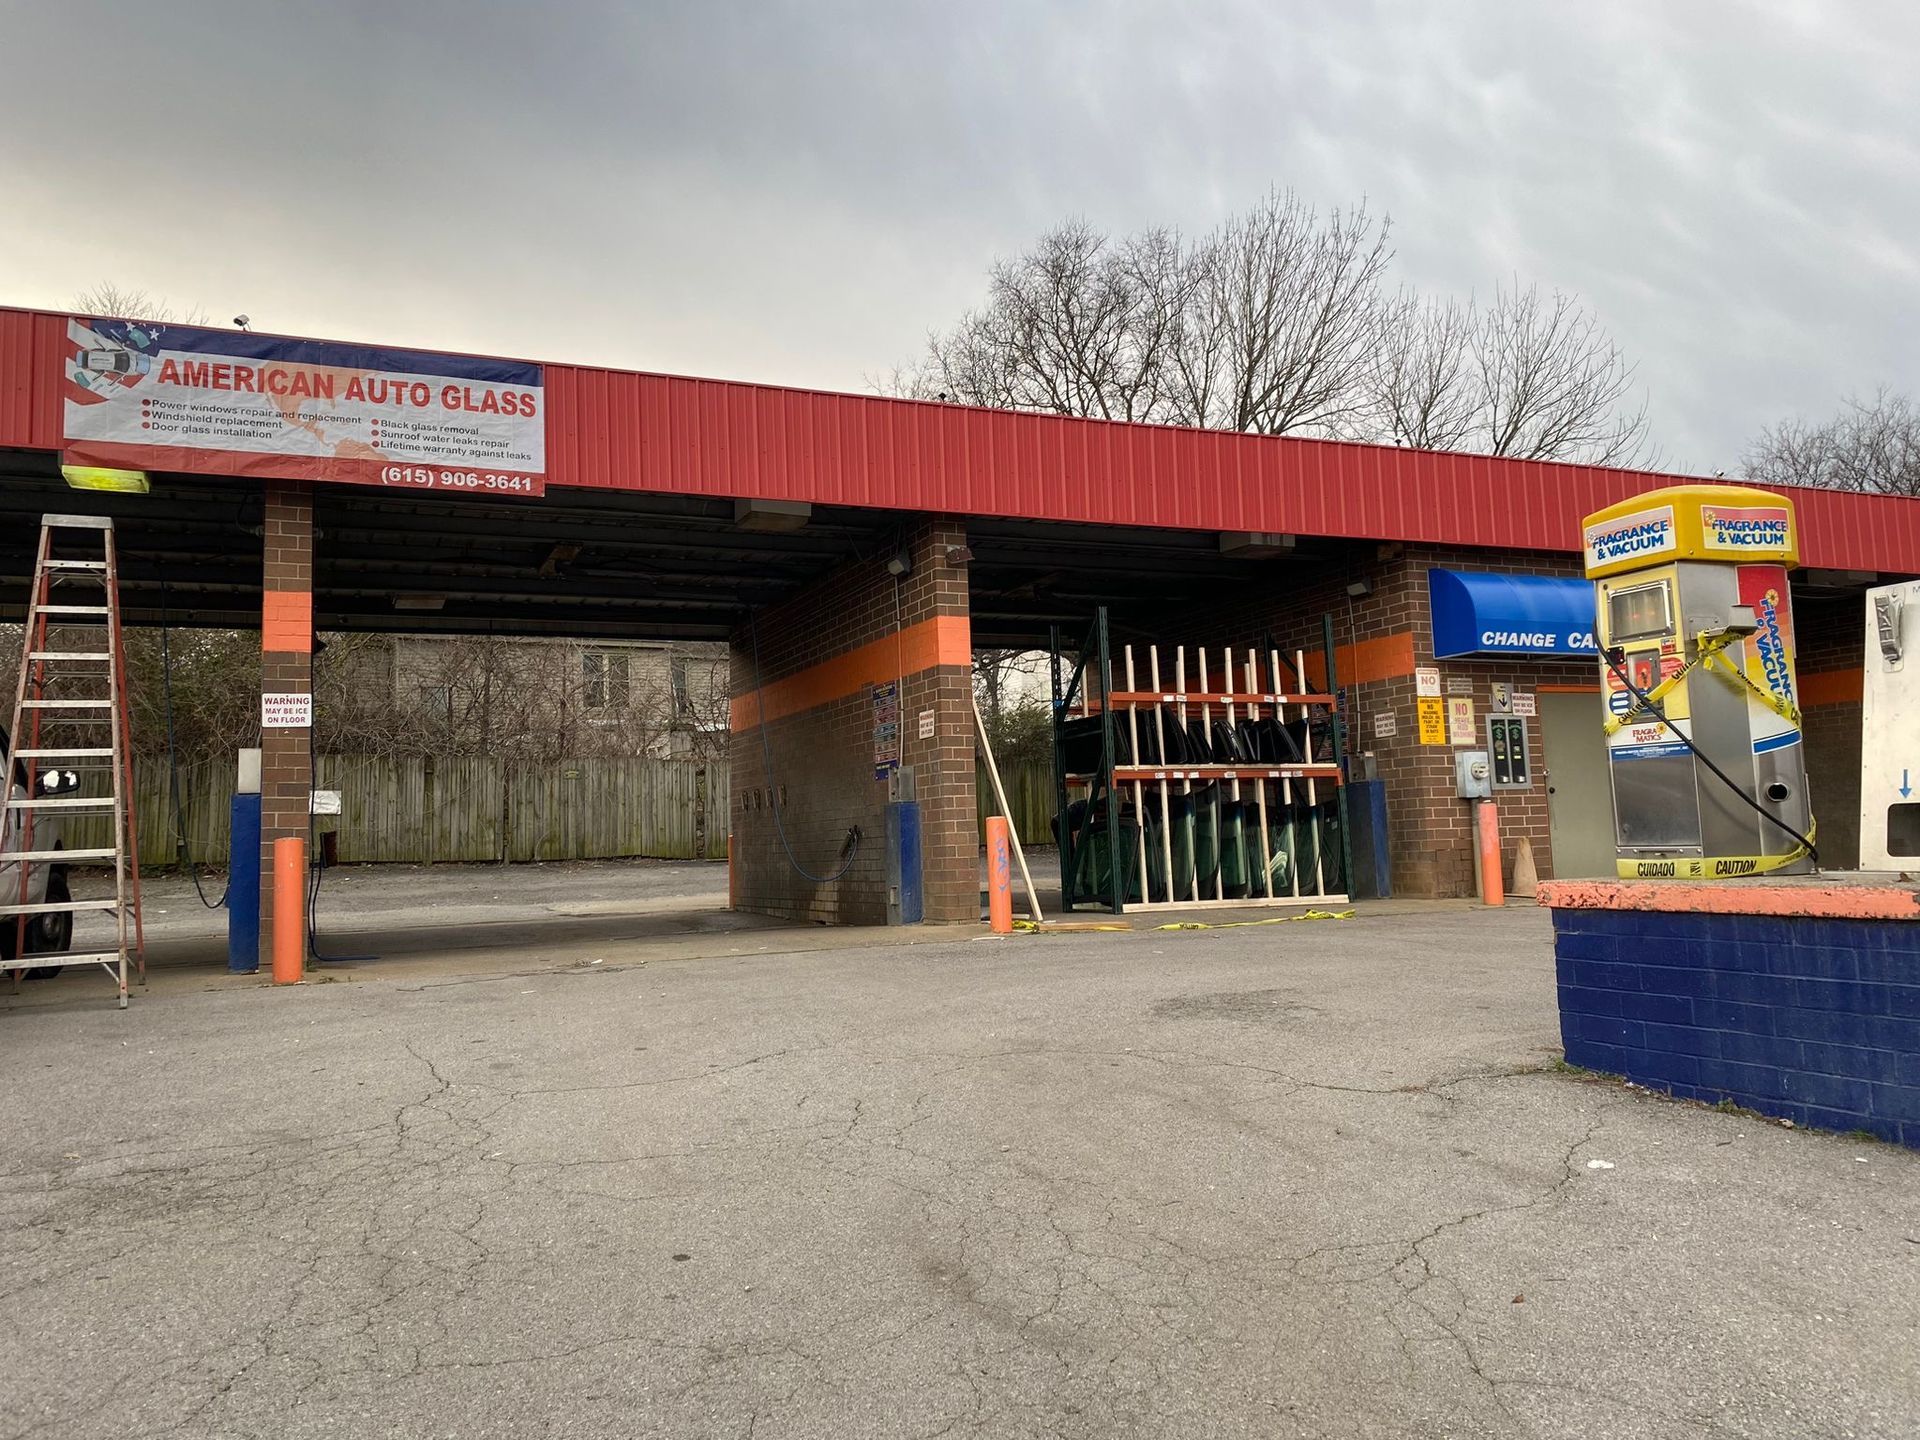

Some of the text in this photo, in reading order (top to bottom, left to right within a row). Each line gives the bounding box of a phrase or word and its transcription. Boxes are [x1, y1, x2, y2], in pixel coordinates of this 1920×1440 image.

[157, 358, 537, 417] AMERICAN AUTO GLASS
[152, 400, 362, 425] Power windows repair and replacement
[152, 411, 283, 430] Windshield replacement
[152, 422, 273, 439] Door glass installation
[381, 420, 479, 435] Black glass removal
[381, 430, 510, 449] Sunroof water leaks repair
[381, 441, 532, 461] Lifetime warranty against leaks
[381, 466, 532, 492] (615) 906-3641
[1712, 519, 1787, 532] FRAGRANCE
[1592, 520, 1669, 549] FRAGRANCE
[1717, 532, 1784, 545] & VACUUM
[1597, 534, 1664, 560] & VACUUM
[1481, 631, 1598, 648] CHANGE CA
[1760, 598, 1795, 704] FRAGRANC
[1421, 676, 1436, 685] NO
[264, 697, 310, 705] WARNING
[1455, 703, 1468, 716] NO
[1632, 727, 1657, 738] FRAGRA
[1636, 734, 1662, 743] MATICS
[1637, 862, 1675, 877] CUIDADO
[1715, 860, 1757, 875] CAUTION
